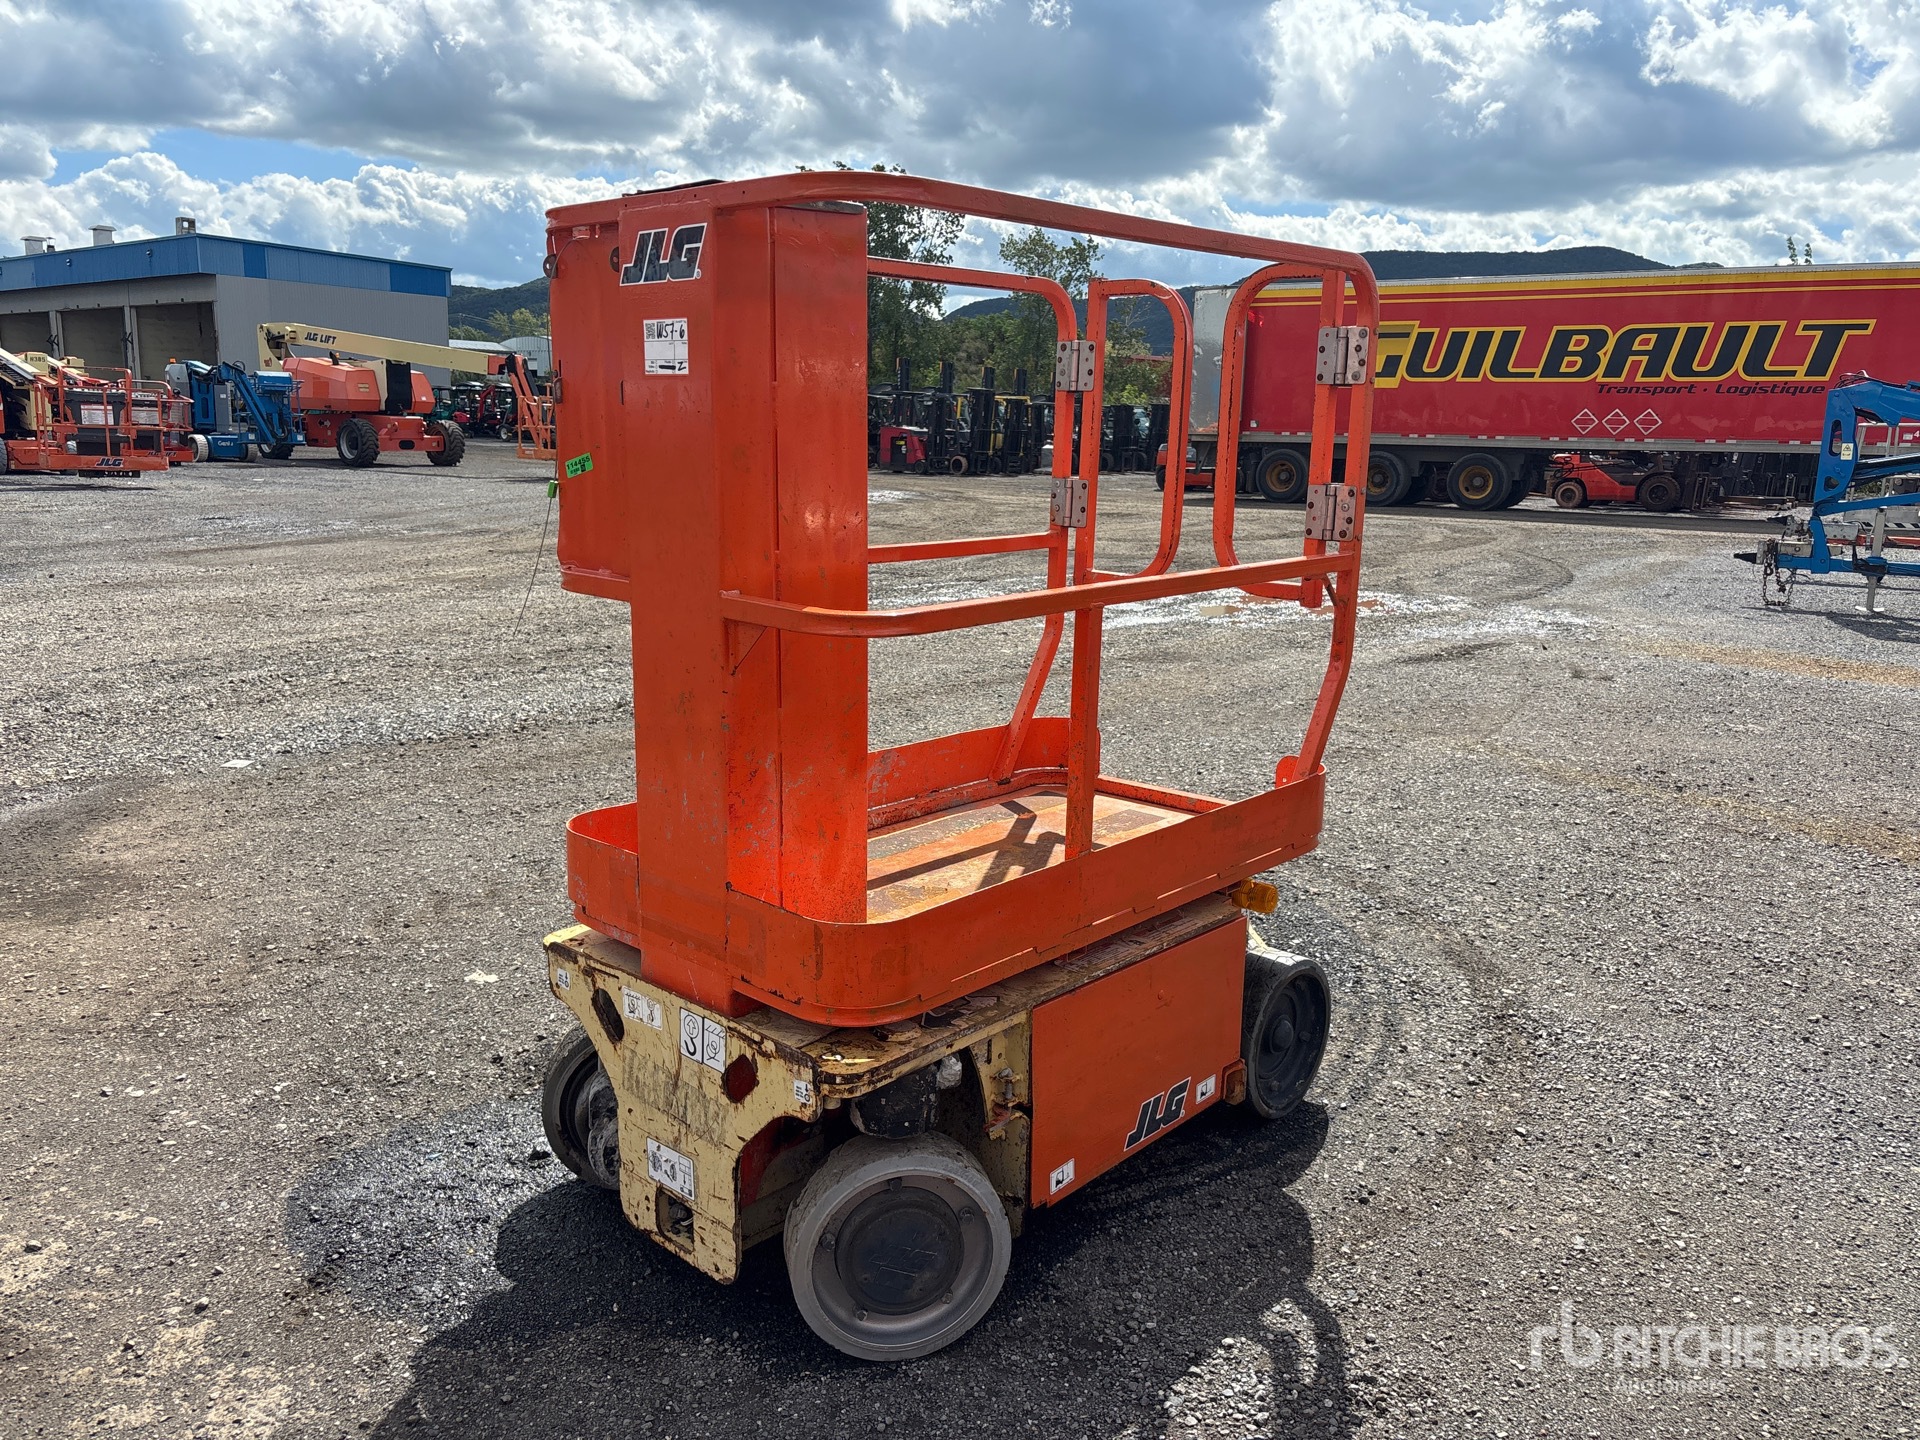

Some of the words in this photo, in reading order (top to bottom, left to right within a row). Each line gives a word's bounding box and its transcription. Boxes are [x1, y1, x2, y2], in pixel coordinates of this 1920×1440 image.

[620, 223, 707, 286] JLG
[304, 332, 319, 341] JLG
[320, 334, 337, 345] LIFT
[1598, 383, 1697, 396] Transport
[1715, 382, 1825, 396] Logistique
[95, 457, 124, 467] JLG
[566, 455, 590, 470] 114455
[1124, 1076, 1191, 1151] JLG
